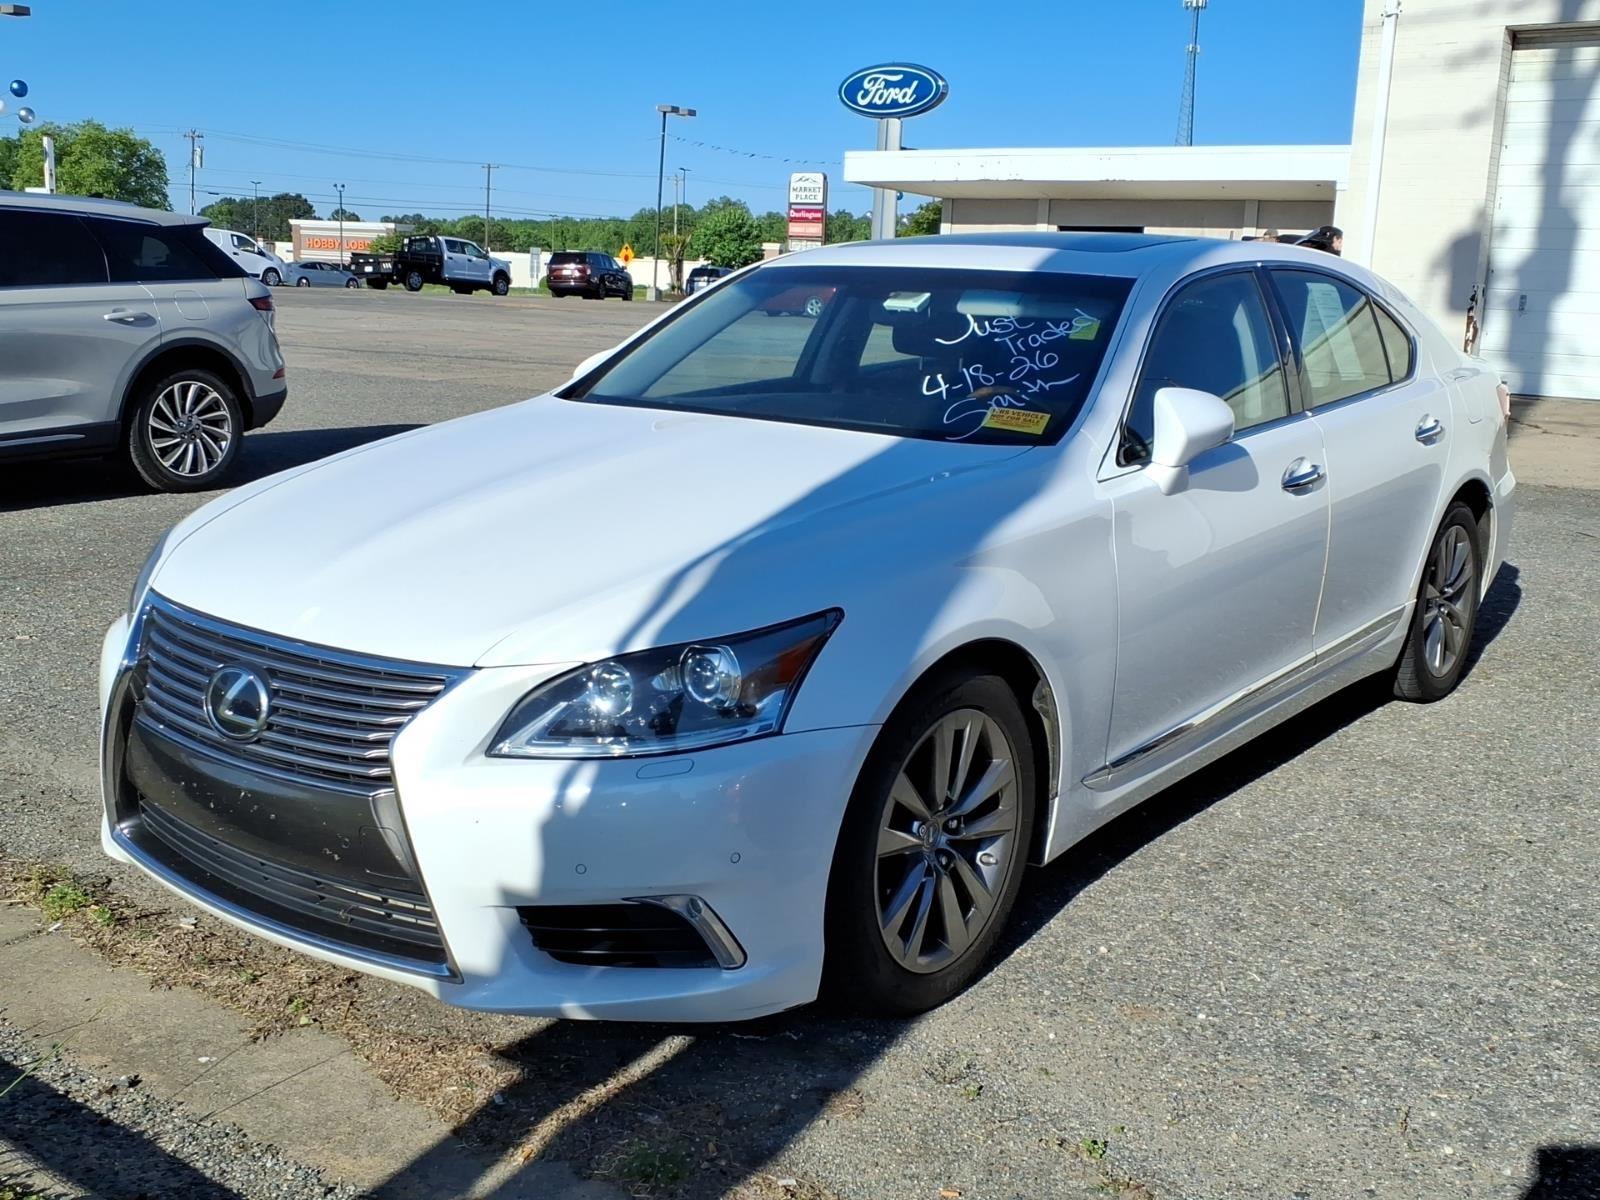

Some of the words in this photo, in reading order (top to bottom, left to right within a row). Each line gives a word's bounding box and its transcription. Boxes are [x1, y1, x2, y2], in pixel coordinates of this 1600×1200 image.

[857, 73, 919, 106] Ford
[306, 237, 341, 249] HOBBY
[344, 239, 372, 250] LOB
[935, 311, 1035, 345] Just
[994, 308, 1098, 355] Traded
[922, 350, 1059, 400] 4-18-26
[1011, 410, 1046, 420] VEHICLE
